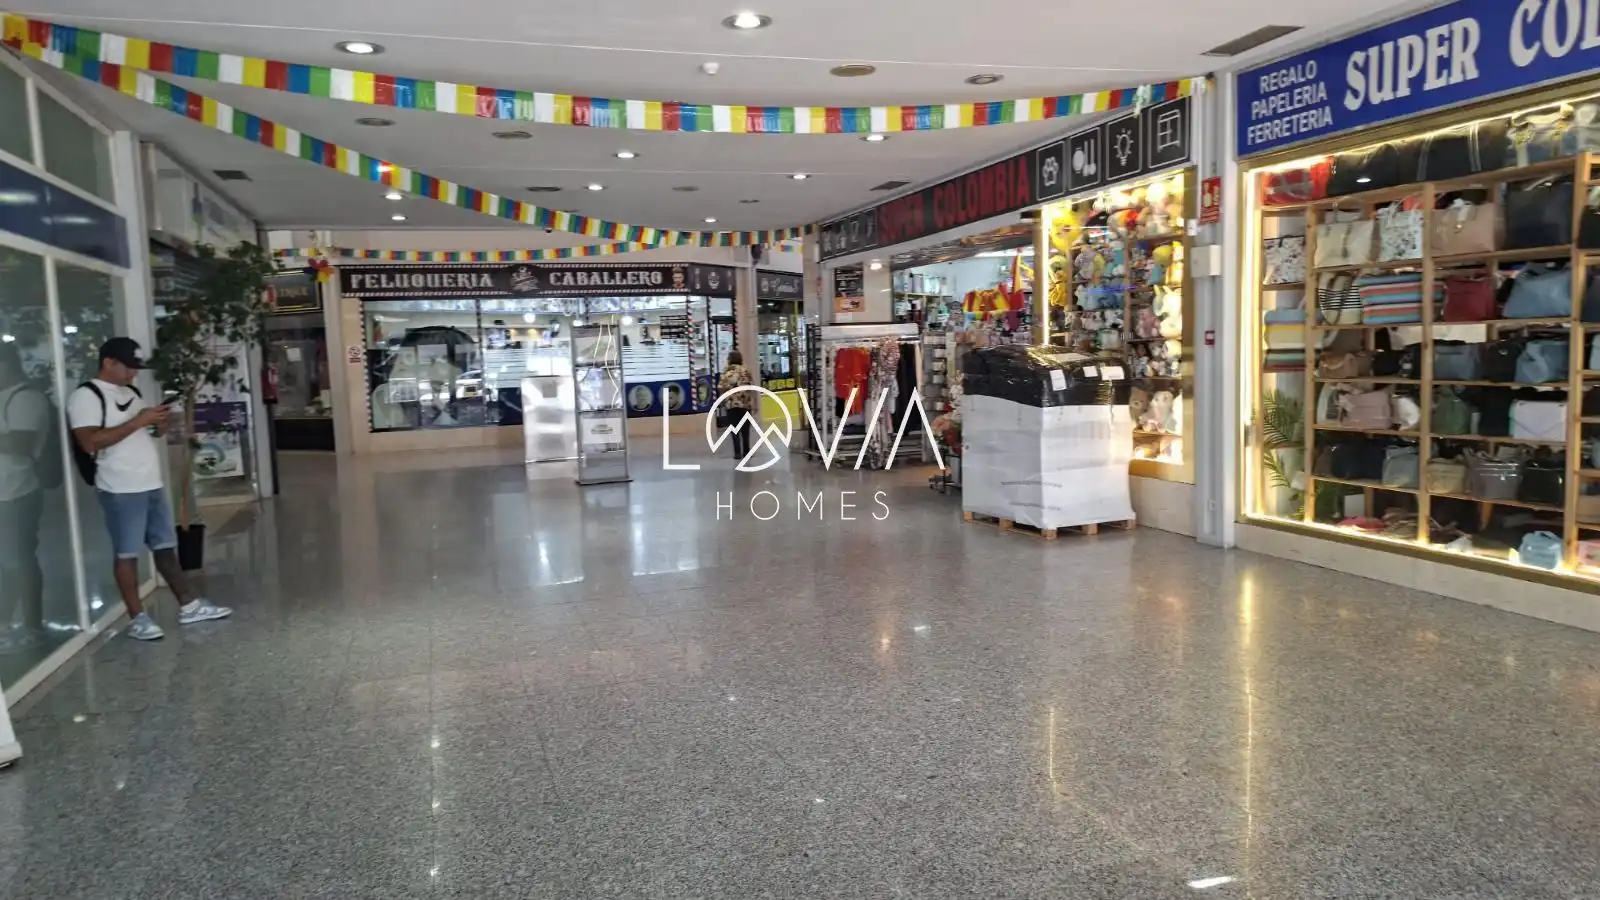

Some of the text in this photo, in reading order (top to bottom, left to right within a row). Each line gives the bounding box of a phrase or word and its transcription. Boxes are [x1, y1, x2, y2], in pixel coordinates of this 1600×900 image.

[1260, 60, 1317, 94] REGALO
[1343, 17, 1481, 111] SUPER
[1251, 81, 1328, 120] PAPELERIA
[1247, 105, 1334, 146] FERRETERIA
[932, 155, 1030, 230] COLOMBIA
[350, 273, 494, 289] PELUQUERIA
[549, 270, 663, 287] CABALLERO
